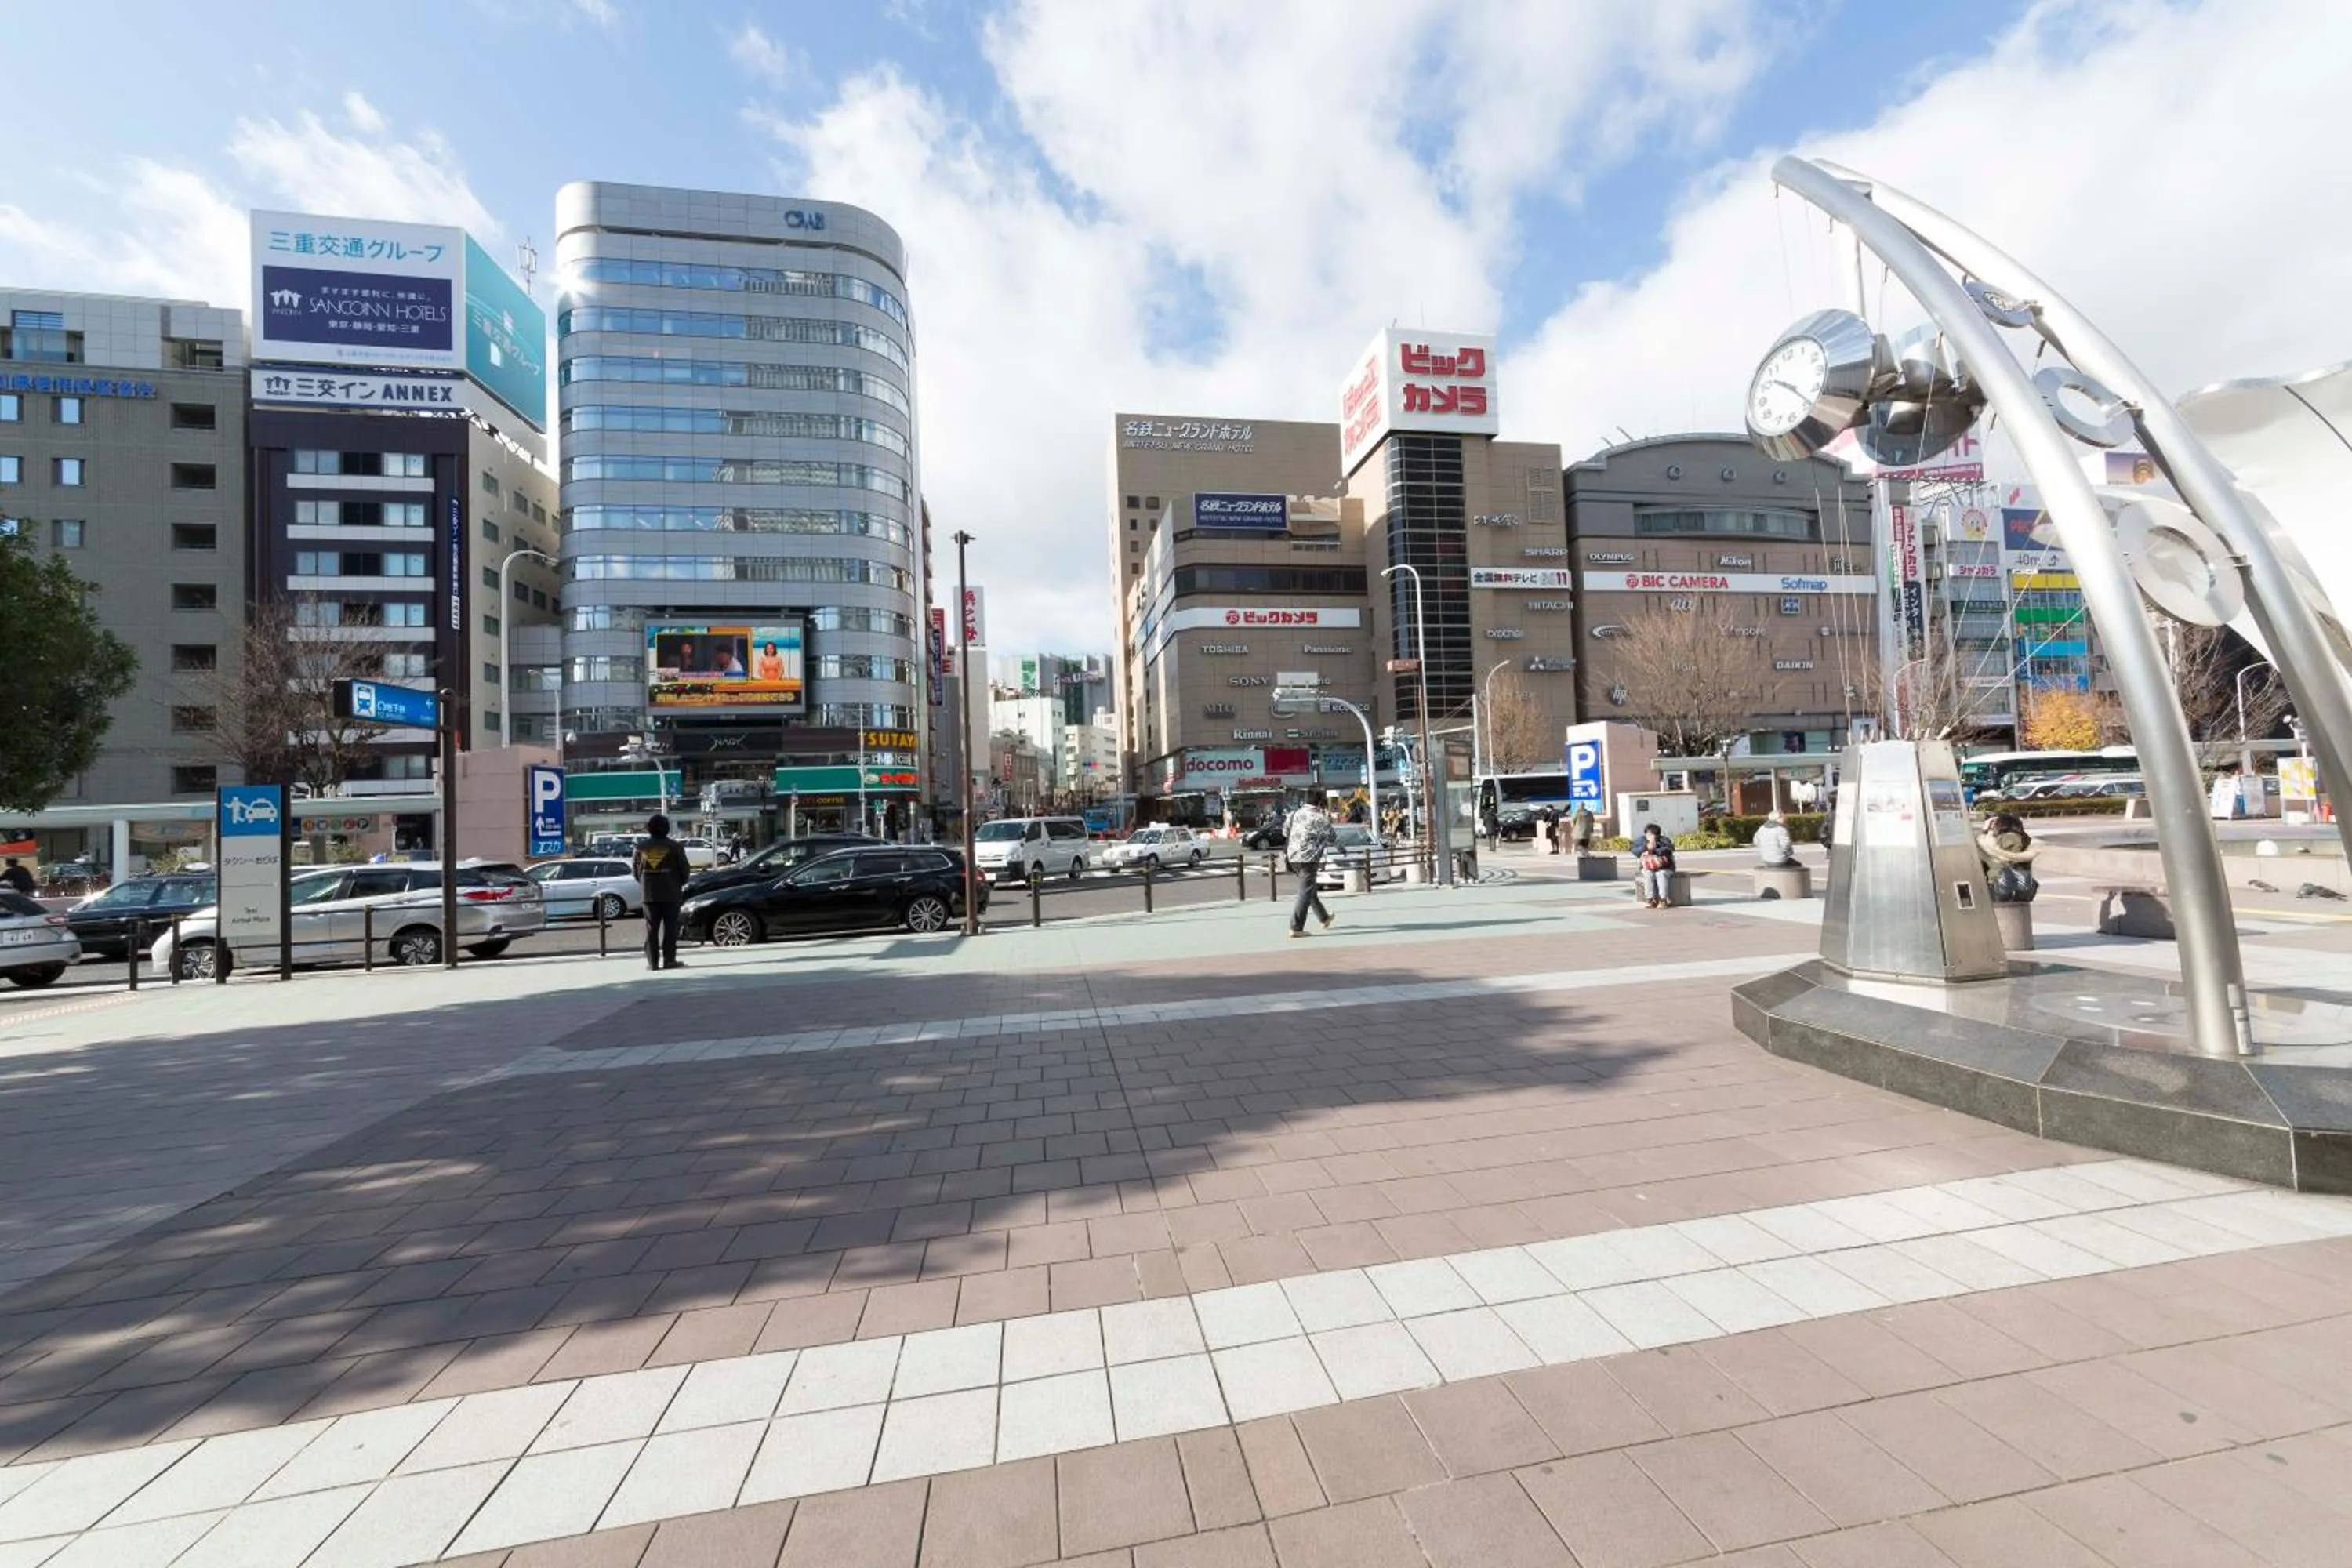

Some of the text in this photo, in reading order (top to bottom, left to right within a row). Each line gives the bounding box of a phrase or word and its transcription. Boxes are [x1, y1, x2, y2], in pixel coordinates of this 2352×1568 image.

[269, 231, 445, 262] 三重交通グループ
[396, 305, 447, 323] HOTELS
[1401, 343, 1486, 378] ビック
[296, 377, 452, 402] 三交イン ANNEX
[1343, 354, 1380, 420] ビック
[1403, 383, 1488, 416] カメラ
[1123, 420, 1253, 441] 名鉄ニューグランドホテル
[1345, 394, 1382, 457] カメラ
[1200, 499, 1283, 513] 名鉄ニューグランドホテル
[1524, 547, 1568, 556] SHARP
[1589, 552, 1635, 561] OLYMPUS
[1719, 555, 1752, 566] Nikon
[1642, 575, 1729, 589] BIC CAMERA
[1780, 576, 1828, 591] Softmap
[1528, 601, 1573, 610] HITACHI
[1243, 611, 1318, 624] ビックカメラ
[1202, 644, 1249, 654] TOSHIBA
[1303, 644, 1353, 654] Panasonic
[1776, 660, 1813, 670] DAIKIN
[1229, 677, 1269, 686] SONY
[1233, 728, 1272, 739] Rinnai
[1186, 757, 1254, 772] docomo
[1570, 745, 1596, 780] P
[534, 771, 561, 813] P
